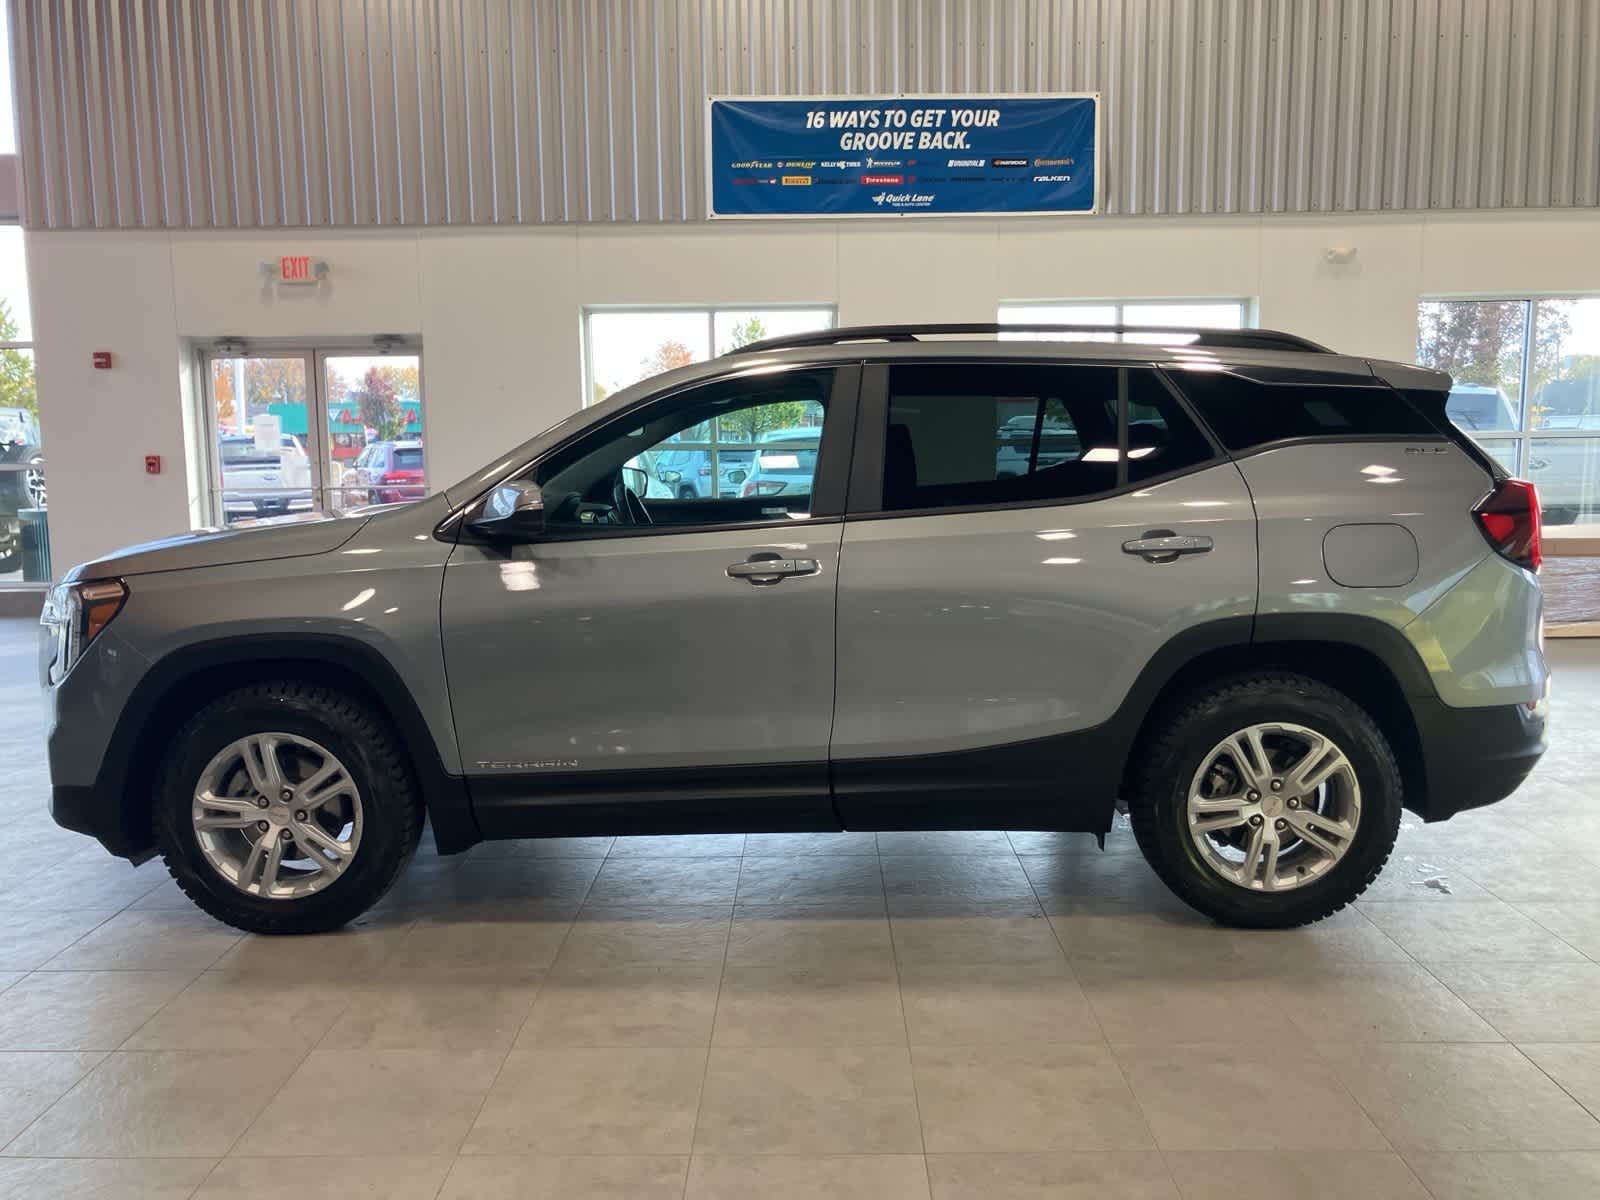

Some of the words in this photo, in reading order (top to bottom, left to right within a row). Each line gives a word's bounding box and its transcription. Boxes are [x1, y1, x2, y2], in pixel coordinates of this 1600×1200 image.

[806, 111, 825, 128] 16
[829, 110, 881, 128] WAYS
[884, 110, 907, 128] TO
[910, 109, 946, 128] GET
[951, 109, 1000, 127] YOUR
[840, 132, 915, 150] GROOVE
[918, 131, 971, 150] BACK.
[886, 194, 910, 203] Quick
[912, 194, 935, 202] Lane
[281, 255, 309, 279] EXIT
